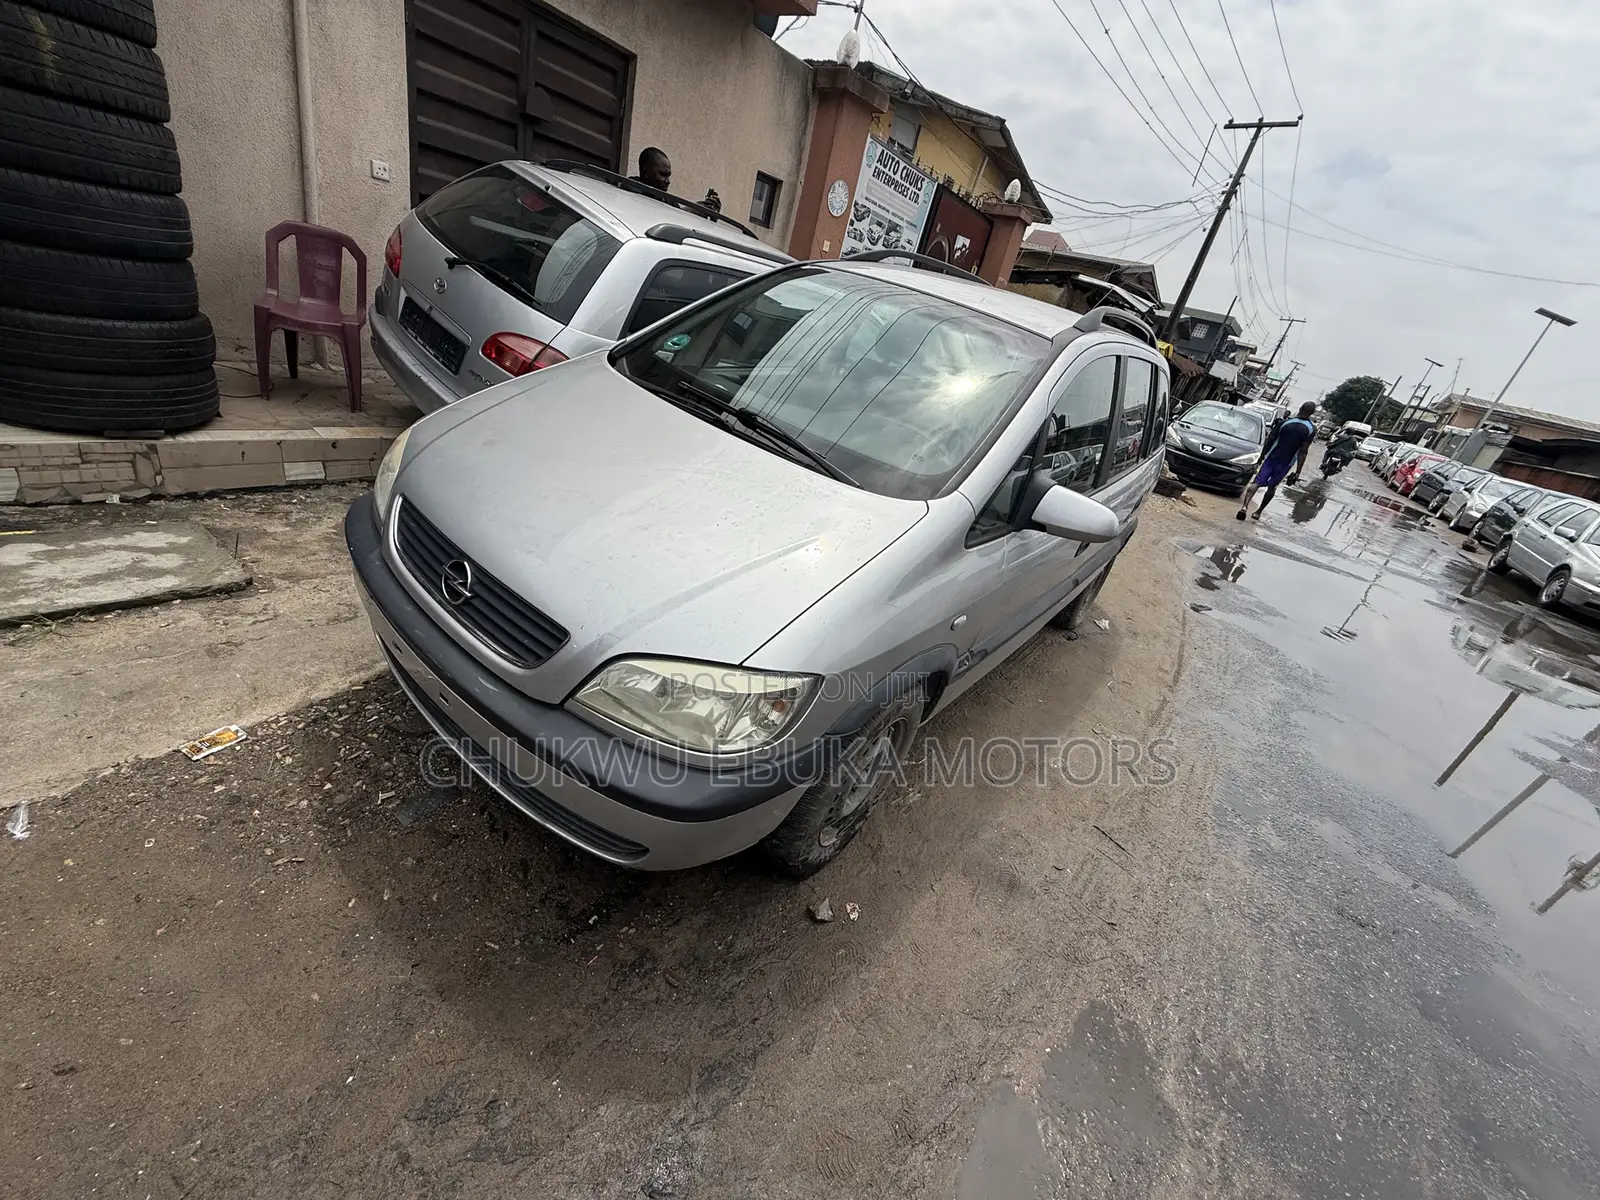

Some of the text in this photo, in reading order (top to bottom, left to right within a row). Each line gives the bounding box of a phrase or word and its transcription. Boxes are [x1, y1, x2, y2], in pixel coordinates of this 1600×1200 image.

[872, 165, 910, 198] ENTERPRISES
[908, 189, 920, 205] LTD.
[876, 149, 925, 192] AUTO CHUKS
